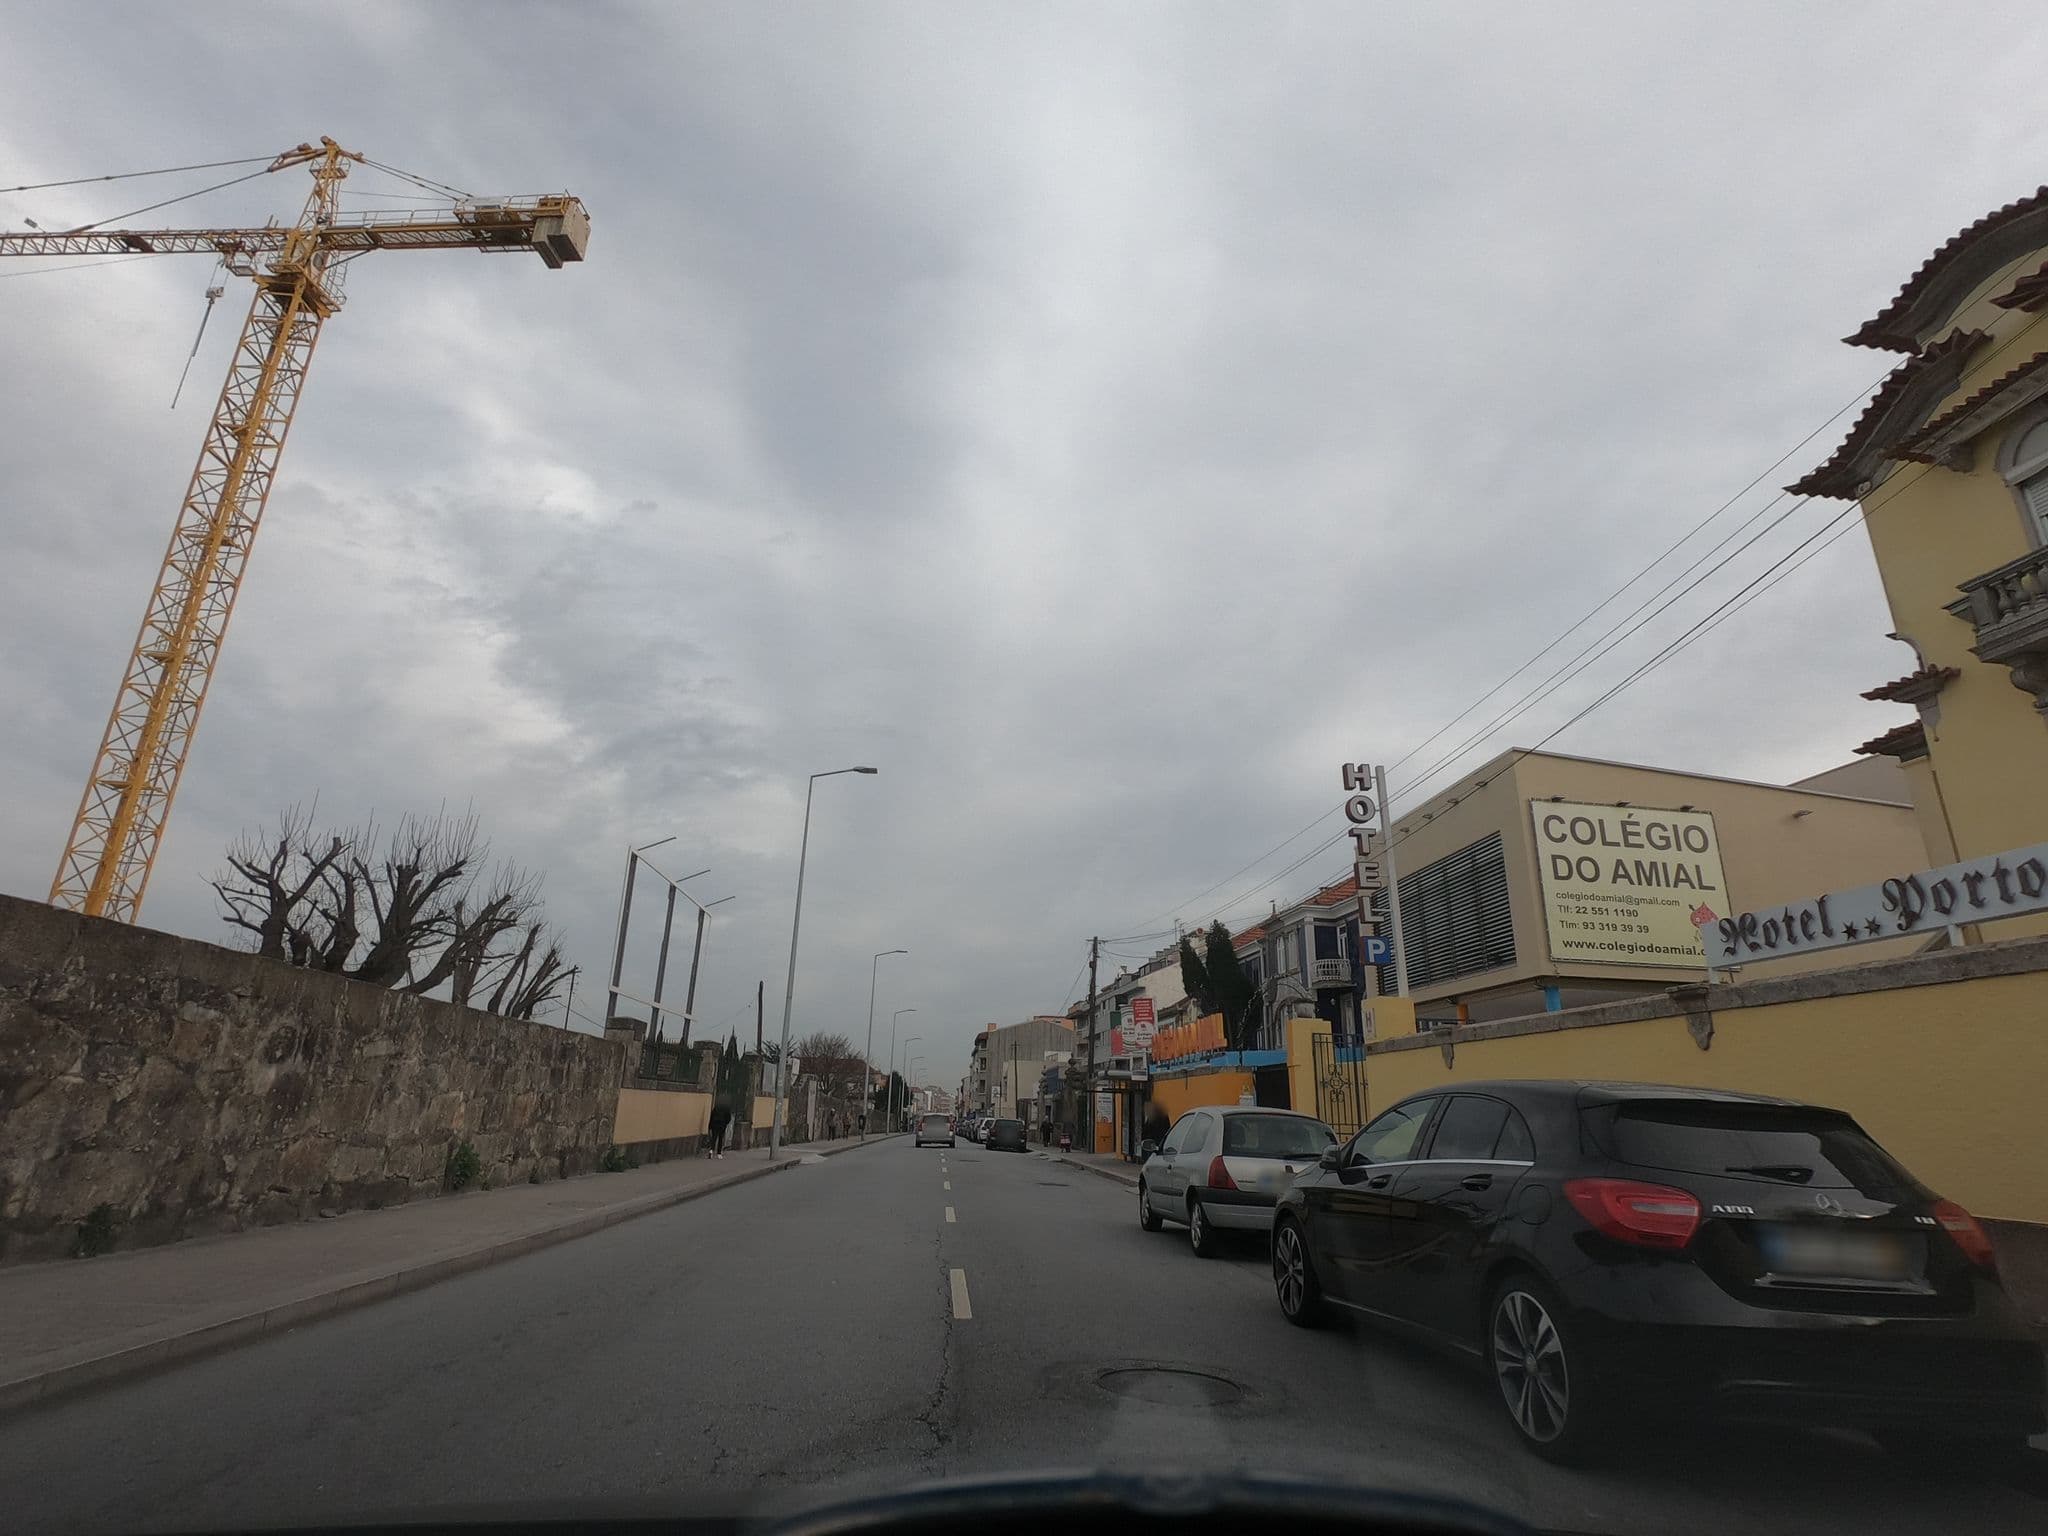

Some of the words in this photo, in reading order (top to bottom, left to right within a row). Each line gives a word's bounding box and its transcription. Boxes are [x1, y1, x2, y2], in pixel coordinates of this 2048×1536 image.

[1342, 763, 1385, 924] HOTEL
[1543, 812, 1710, 853] COLÉGIO
[1550, 854, 1601, 883] DO
[1611, 859, 1716, 891] AMIAL
[1555, 891, 1681, 907] colegiodoamial@gmail.com
[1575, 905, 1588, 915] 22
[1591, 906, 1610, 916] 551
[1613, 908, 1639, 918] 1190
[1717, 894, 1834, 958] Hotel
[1881, 856, 2047, 932] Porto
[1559, 920, 1580, 930] Tlm:
[1582, 921, 1596, 930] 93
[1598, 922, 1618, 932] 319
[1620, 923, 1634, 932] 39
[1636, 924, 1650, 934] 39
[1367, 939, 1386, 963] P
